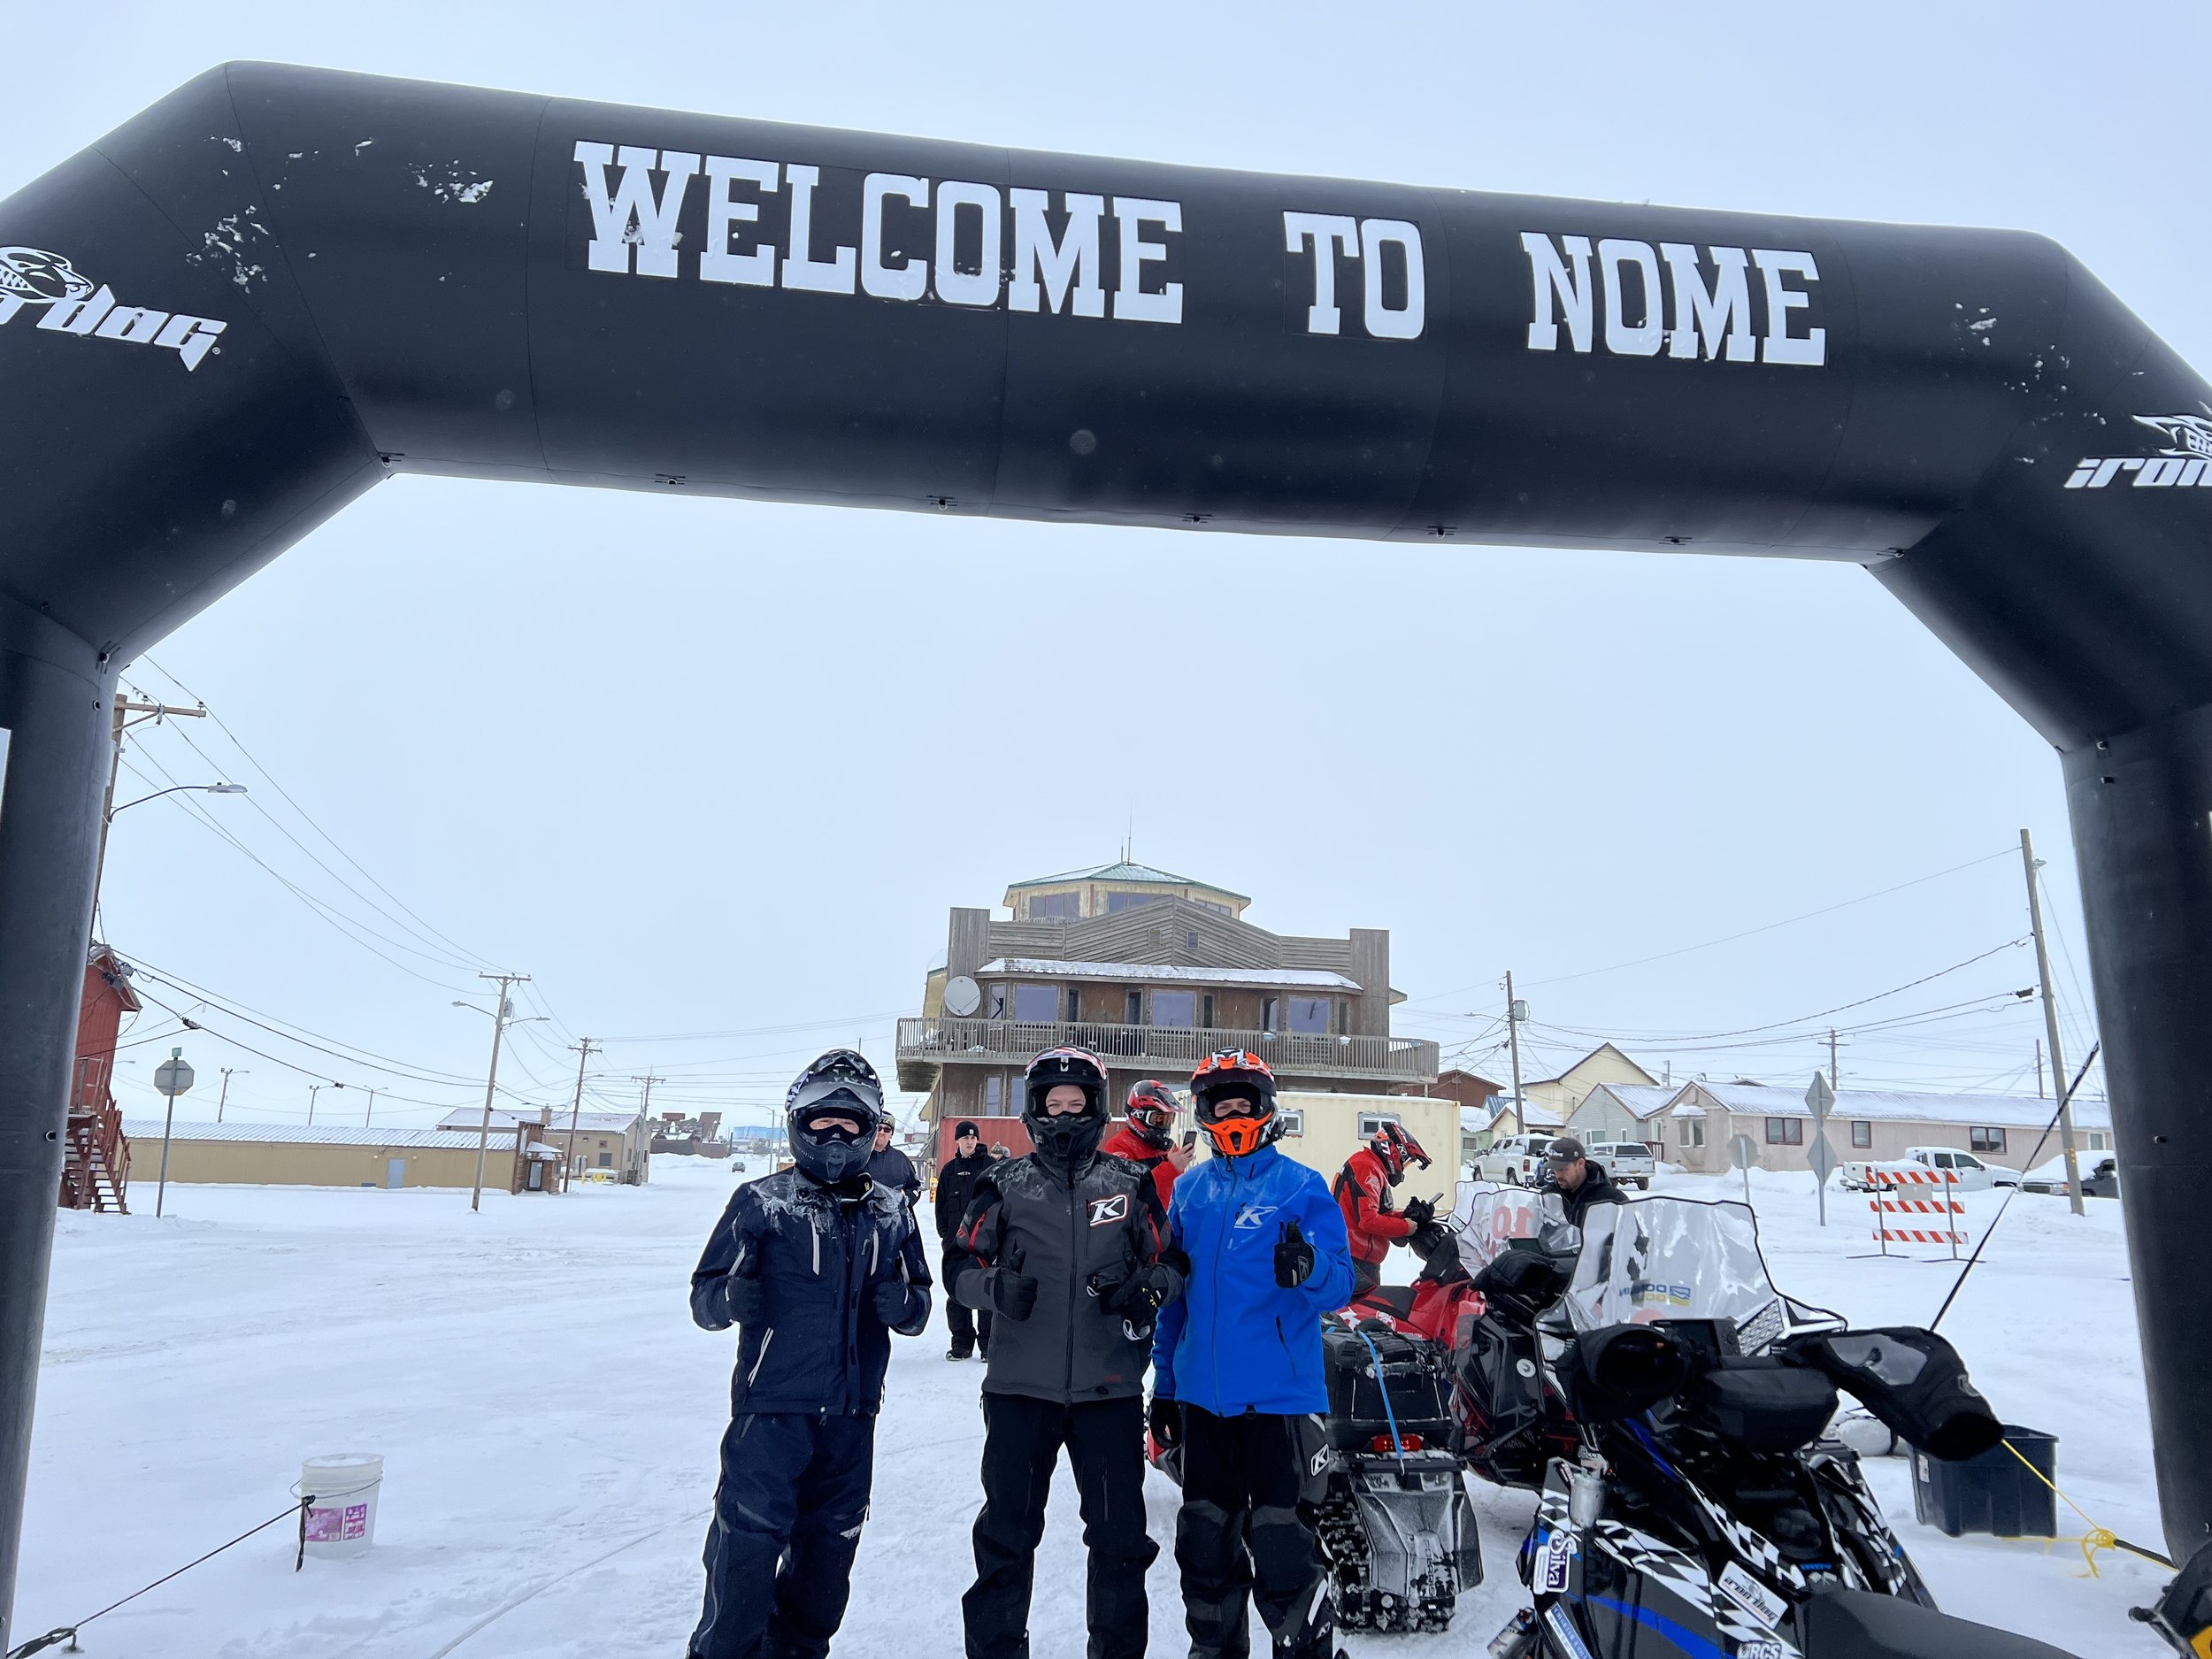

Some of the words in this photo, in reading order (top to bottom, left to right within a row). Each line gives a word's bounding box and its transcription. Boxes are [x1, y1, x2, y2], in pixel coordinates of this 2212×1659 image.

[573, 141, 1184, 324] WELCOME
[1283, 211, 1426, 339] TO
[1519, 231, 1826, 365] NOME
[1425, 1538, 1437, 1598] POLARIS
[1548, 1530, 1578, 1586] Silva
